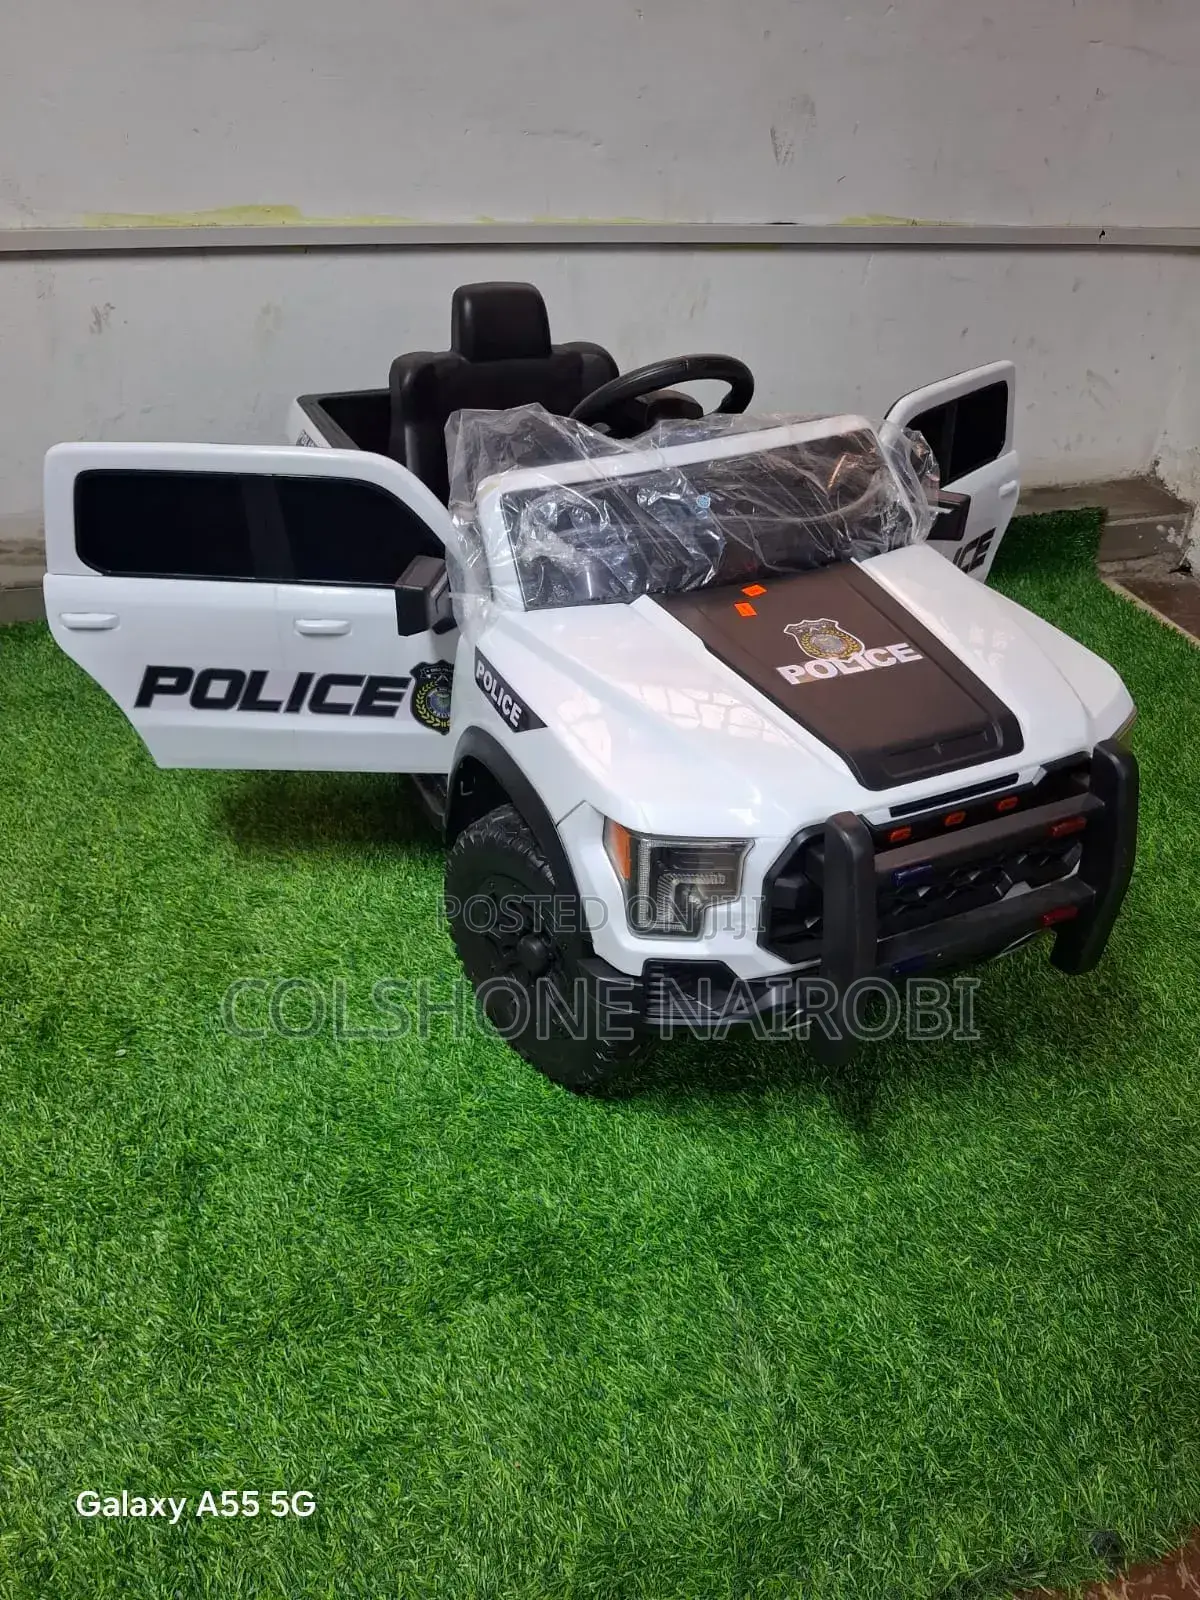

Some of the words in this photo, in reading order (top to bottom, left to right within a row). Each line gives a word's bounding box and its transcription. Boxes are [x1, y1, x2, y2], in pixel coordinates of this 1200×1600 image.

[776, 642, 924, 685] POLICE
[134, 665, 413, 718] POLICE
[476, 659, 522, 727] POLICE
